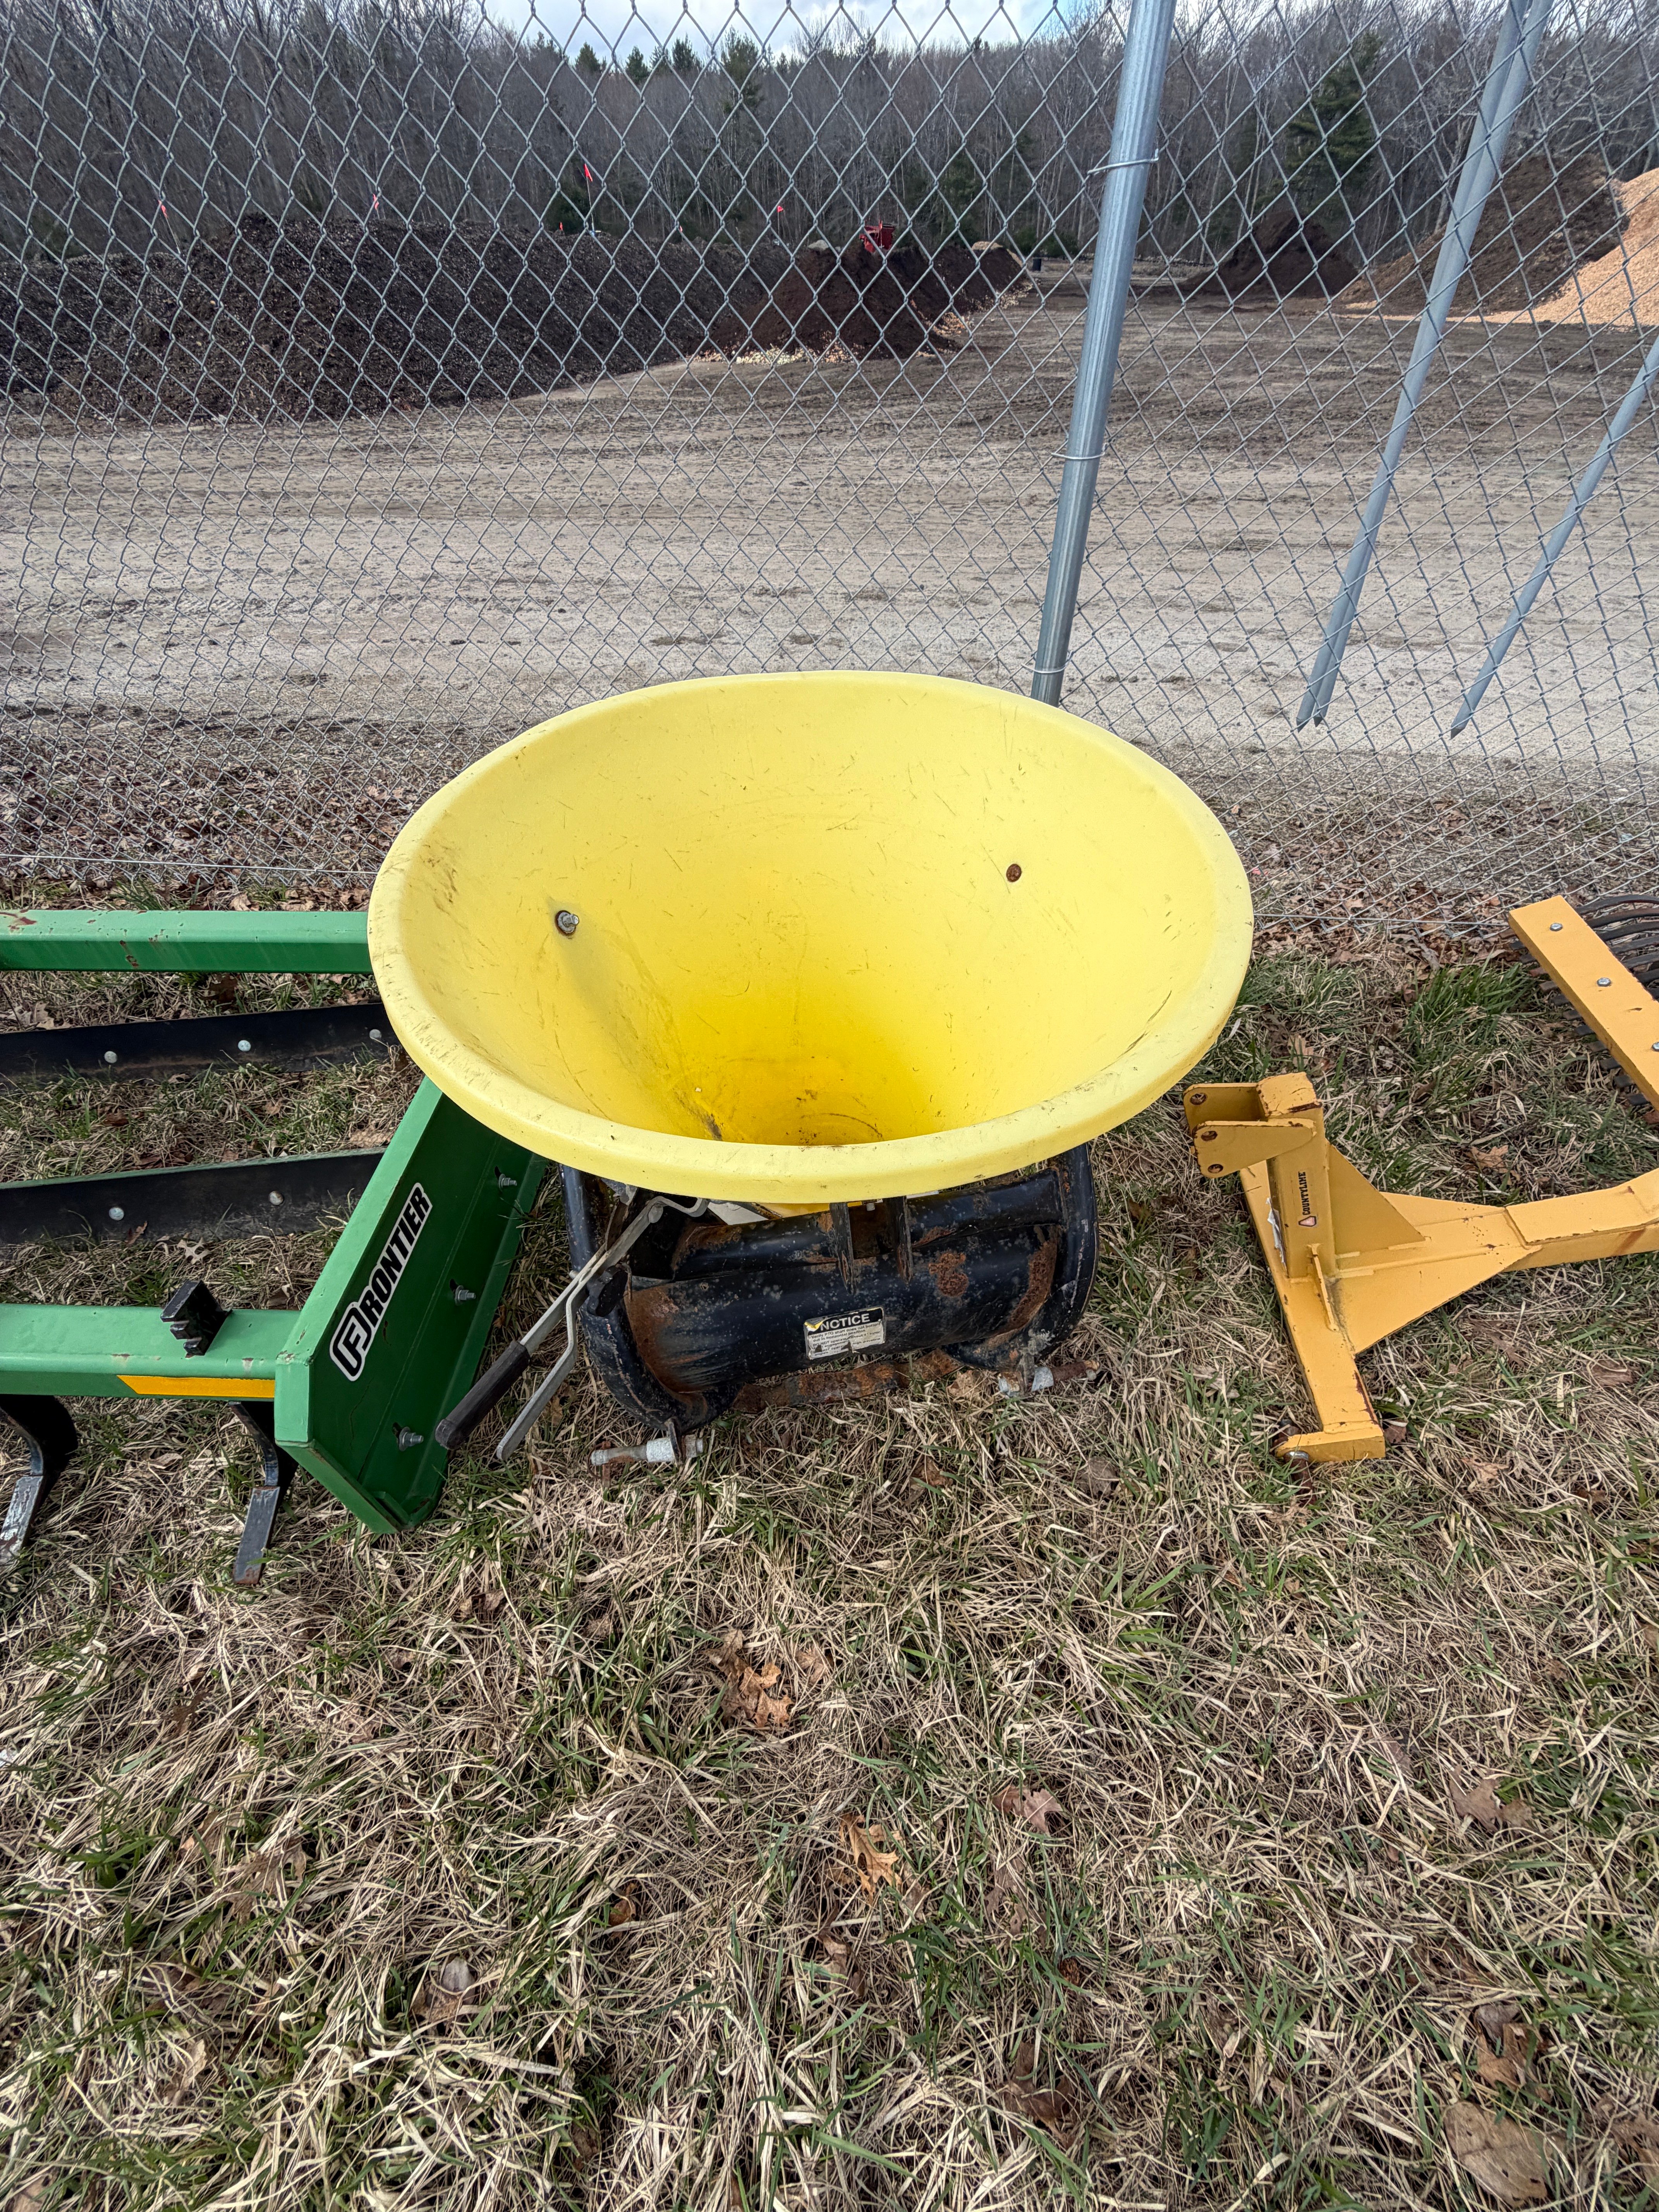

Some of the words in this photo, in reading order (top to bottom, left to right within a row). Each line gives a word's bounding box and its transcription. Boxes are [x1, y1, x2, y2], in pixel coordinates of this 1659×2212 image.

[1298, 1171, 1310, 1215] COUNTYLINE
[332, 1187, 430, 1377] FRONTIER
[820, 1313, 870, 1331] NOTICE
